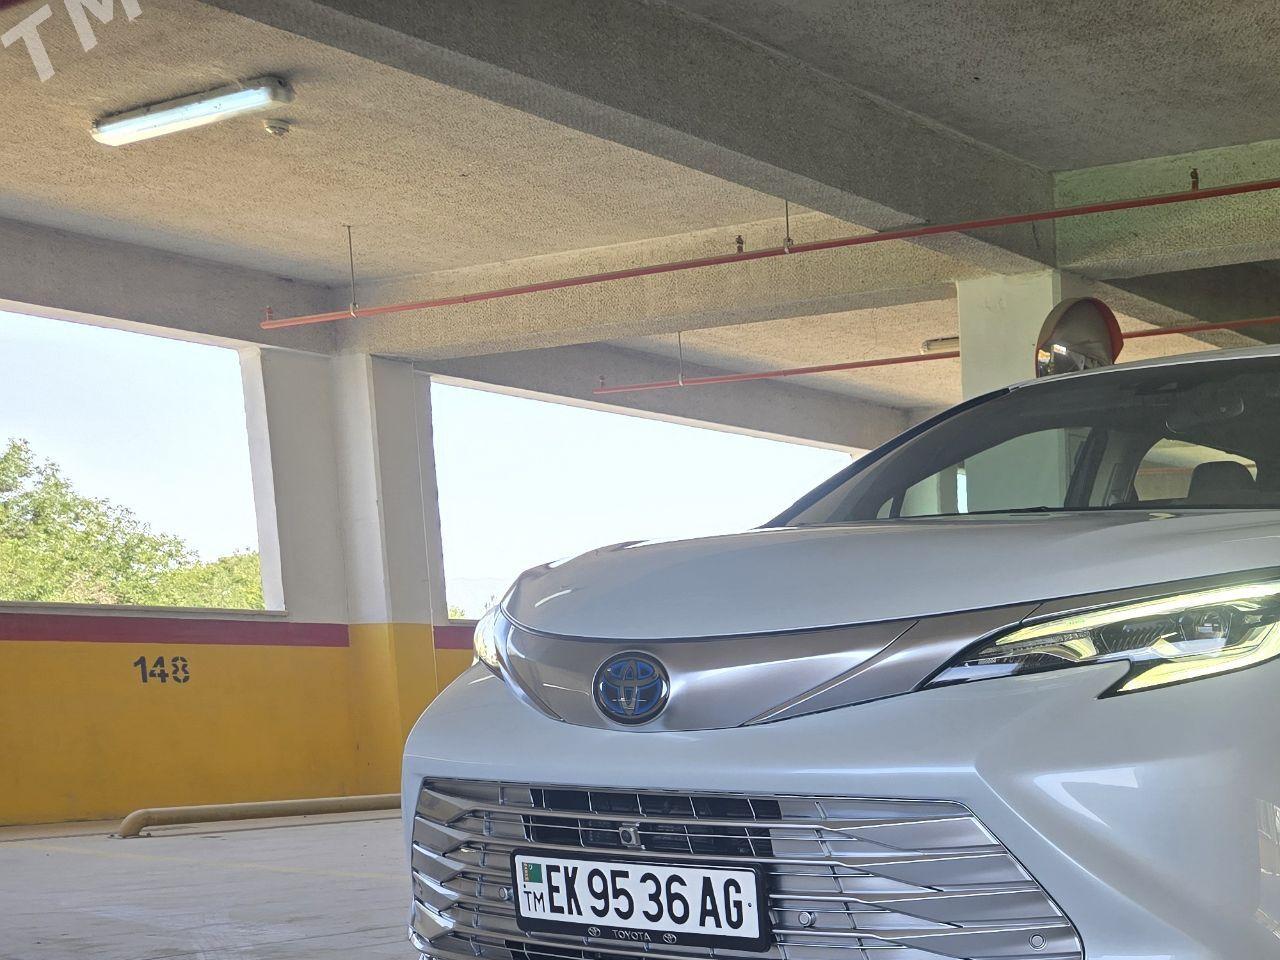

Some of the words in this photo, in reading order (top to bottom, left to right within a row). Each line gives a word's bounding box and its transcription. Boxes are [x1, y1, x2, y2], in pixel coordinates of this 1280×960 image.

[133, 655, 190, 683] 148
[523, 890, 546, 913] TM
[611, 929, 652, 942] TOYOTA
